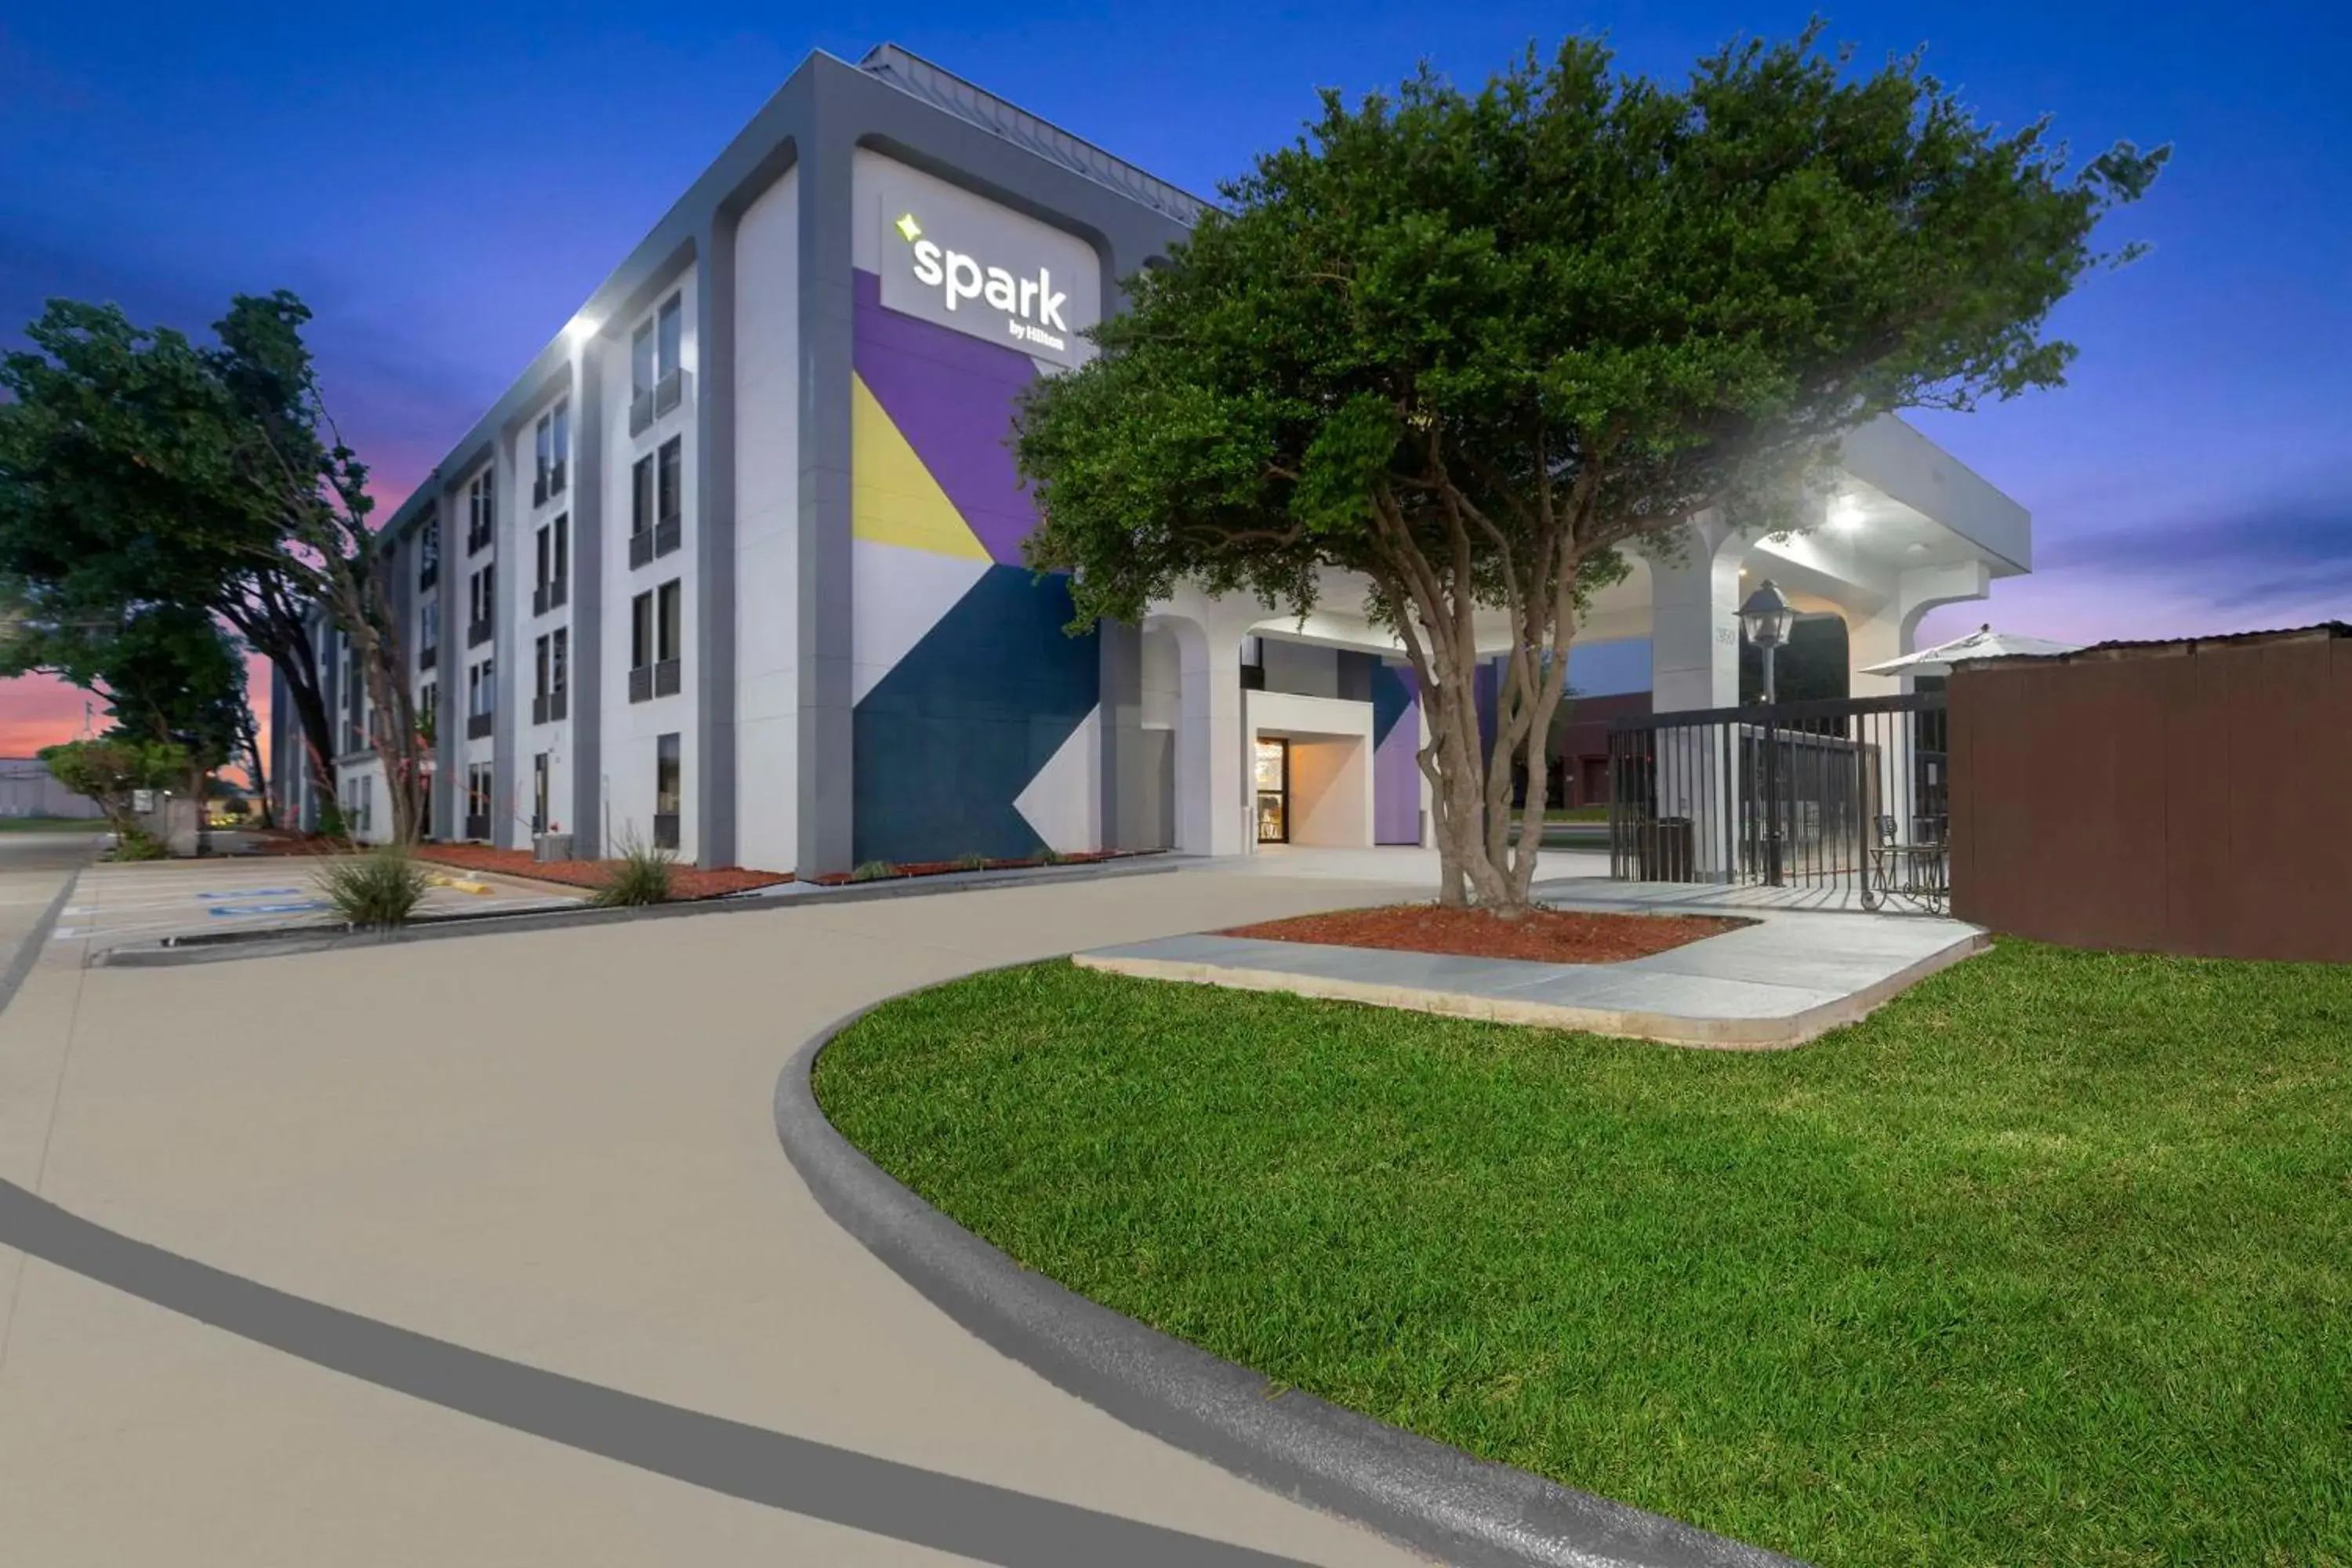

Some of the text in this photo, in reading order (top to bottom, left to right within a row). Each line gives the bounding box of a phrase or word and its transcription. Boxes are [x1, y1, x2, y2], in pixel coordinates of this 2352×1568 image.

[913, 239, 1067, 332] spark
[1009, 319, 1065, 351] by Hilton
